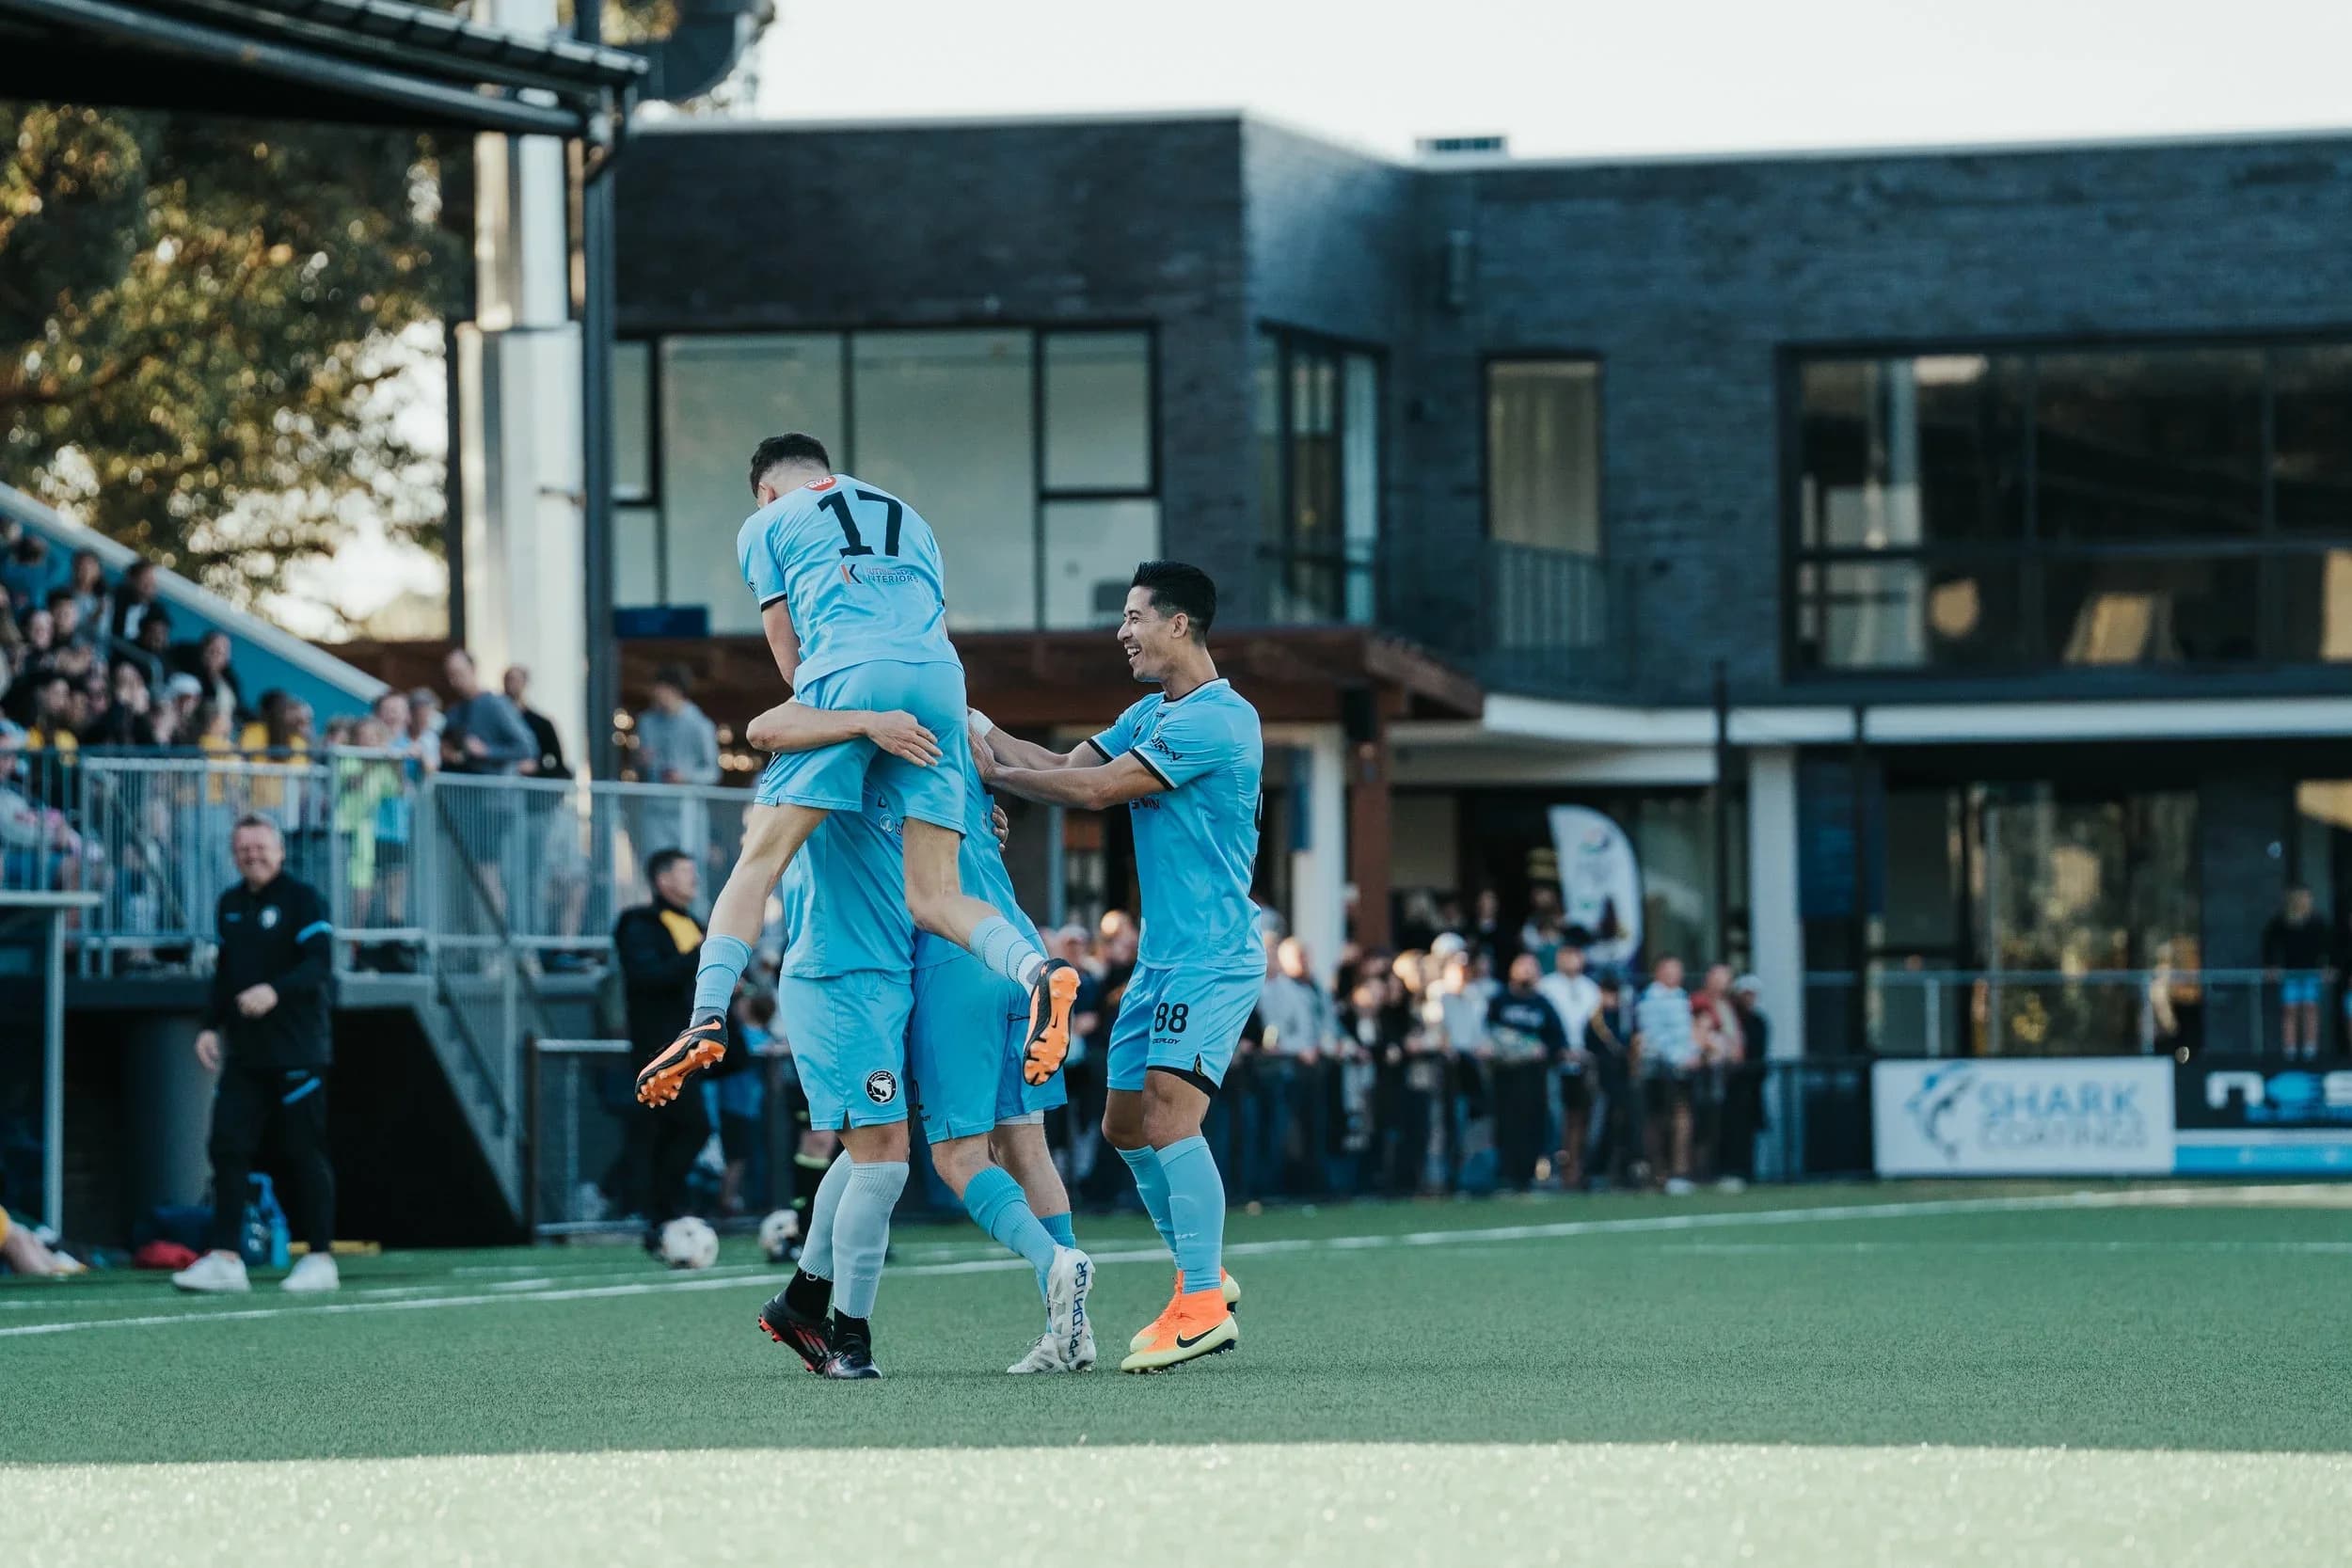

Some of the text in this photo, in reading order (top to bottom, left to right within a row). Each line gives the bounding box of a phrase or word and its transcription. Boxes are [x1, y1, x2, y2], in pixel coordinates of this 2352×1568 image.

[818, 489, 903, 558] 17
[1154, 1002, 1190, 1033] 88
[1979, 1082, 2141, 1117] SHARK
